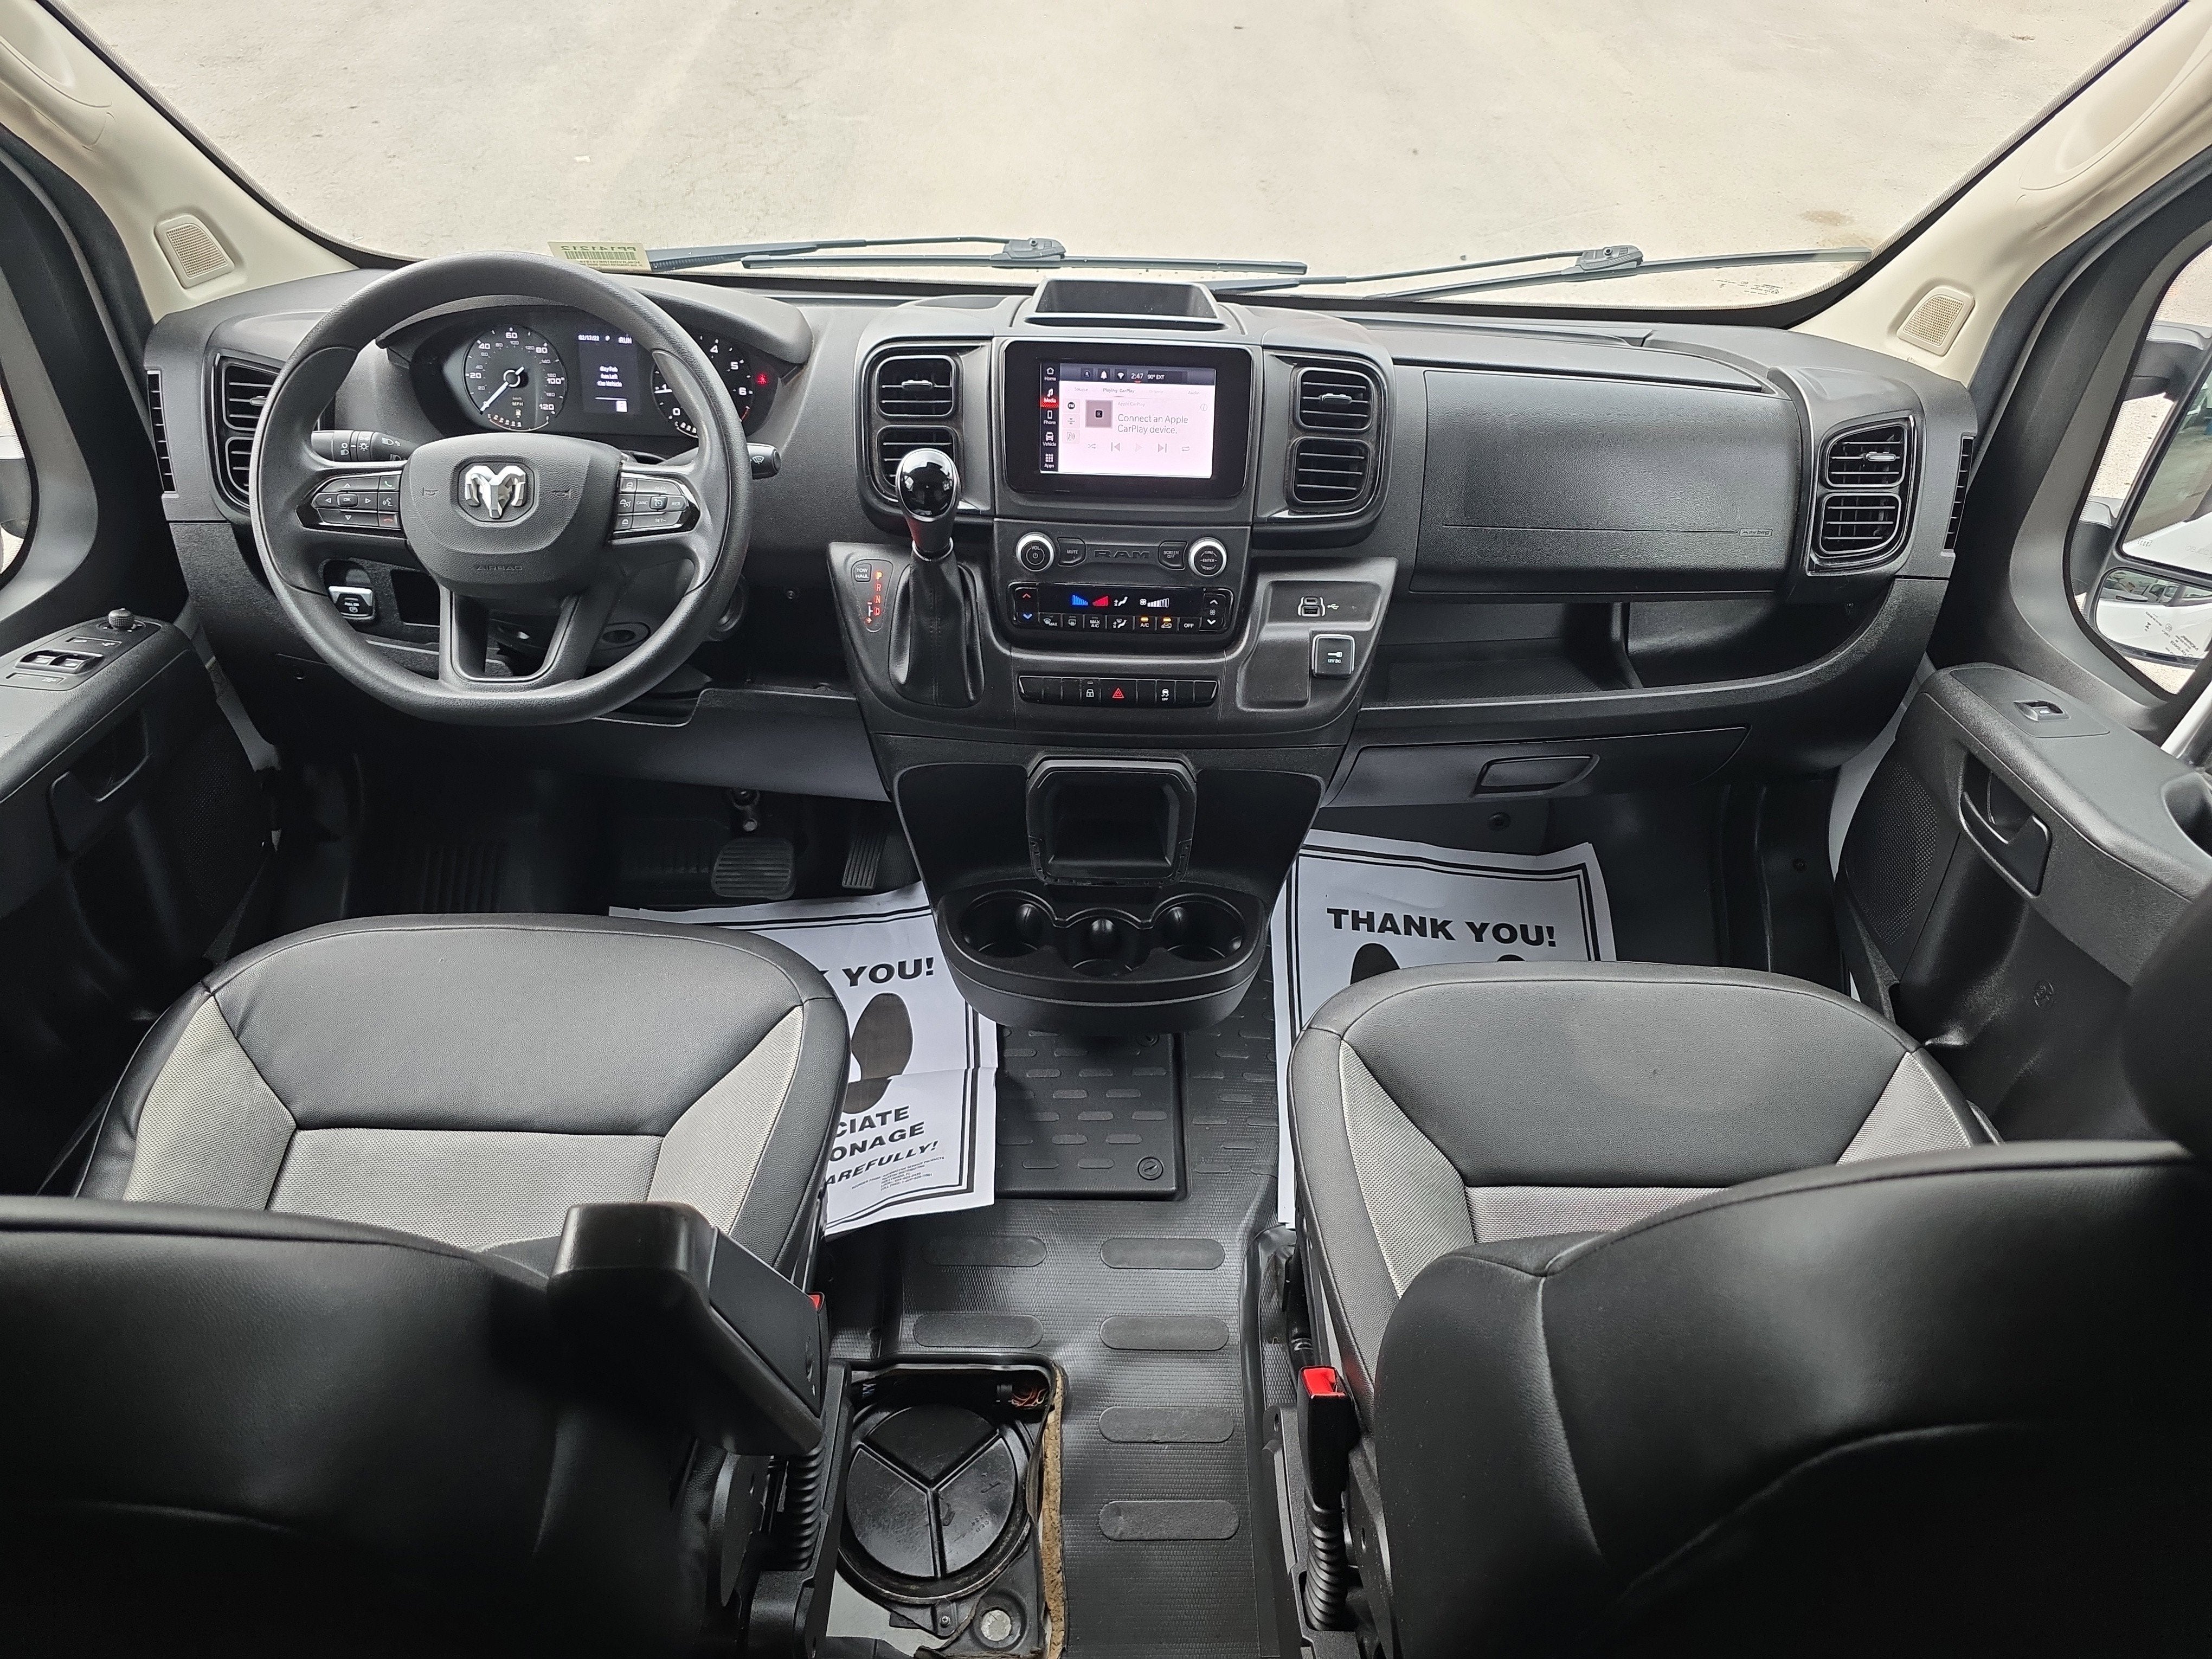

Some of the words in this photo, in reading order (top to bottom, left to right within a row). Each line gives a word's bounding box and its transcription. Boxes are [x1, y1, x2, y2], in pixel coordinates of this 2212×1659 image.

[710, 345, 718, 353] 4
[730, 362, 738, 370] 5
[738, 387, 747, 396] 6
[672, 408, 680, 416] 0
[1118, 414, 1152, 423] Connect
[1165, 415, 1188, 425] Apple
[1117, 425, 1148, 435] CarPlay
[1149, 426, 1178, 434] device.
[1094, 550, 1150, 558] RAM
[876, 571, 882, 580] P
[876, 583, 882, 591] R
[875, 595, 881, 604] N
[875, 607, 881, 616] D
[1326, 907, 1457, 941] THANK
[1465, 921, 1557, 947] YOU!
[841, 956, 934, 987] YOU!
[829, 1121, 925, 1162] ONAGE
[825, 1140, 939, 1185] AREFULLY!
